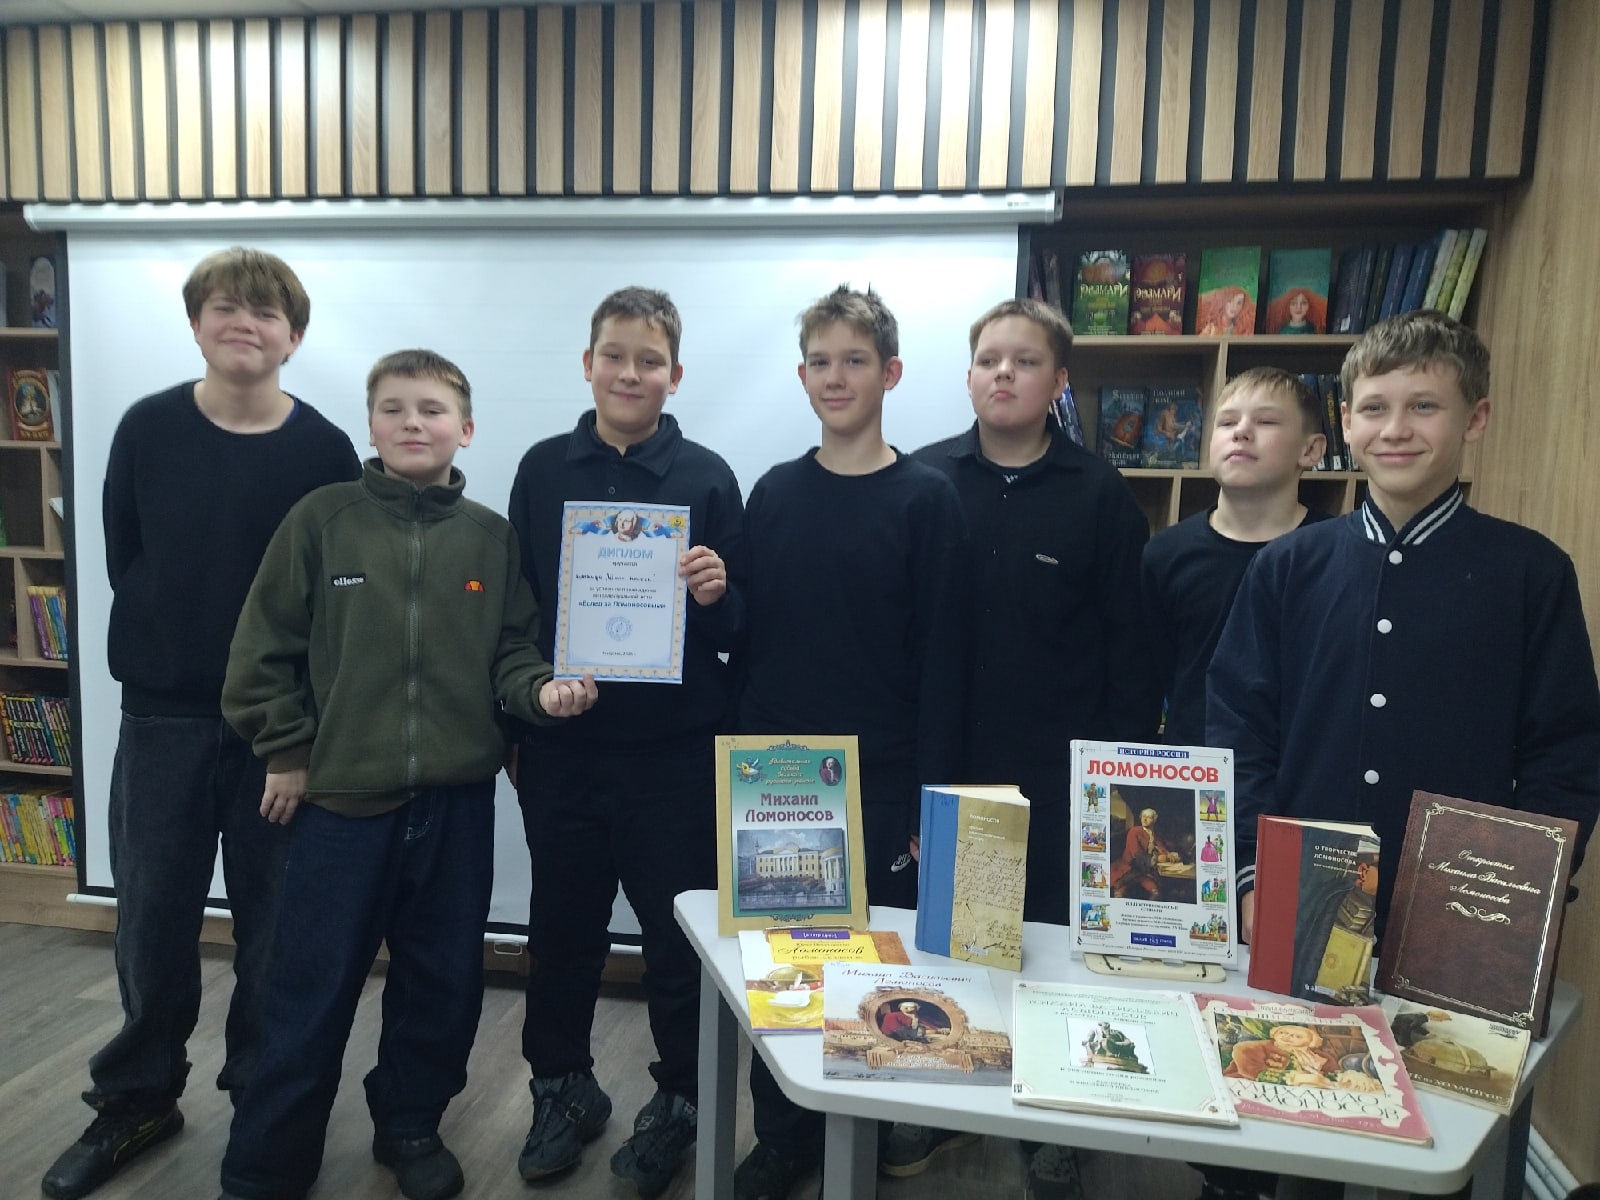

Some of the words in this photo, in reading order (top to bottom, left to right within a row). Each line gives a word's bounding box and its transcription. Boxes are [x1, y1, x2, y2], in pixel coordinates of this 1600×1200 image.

[598, 547, 653, 559] ДИПЛОМ
[1087, 759, 1219, 783] ЛОМОНОСОВ
[760, 792, 819, 806] Михаил
[745, 810, 834, 823] Ломоносов
